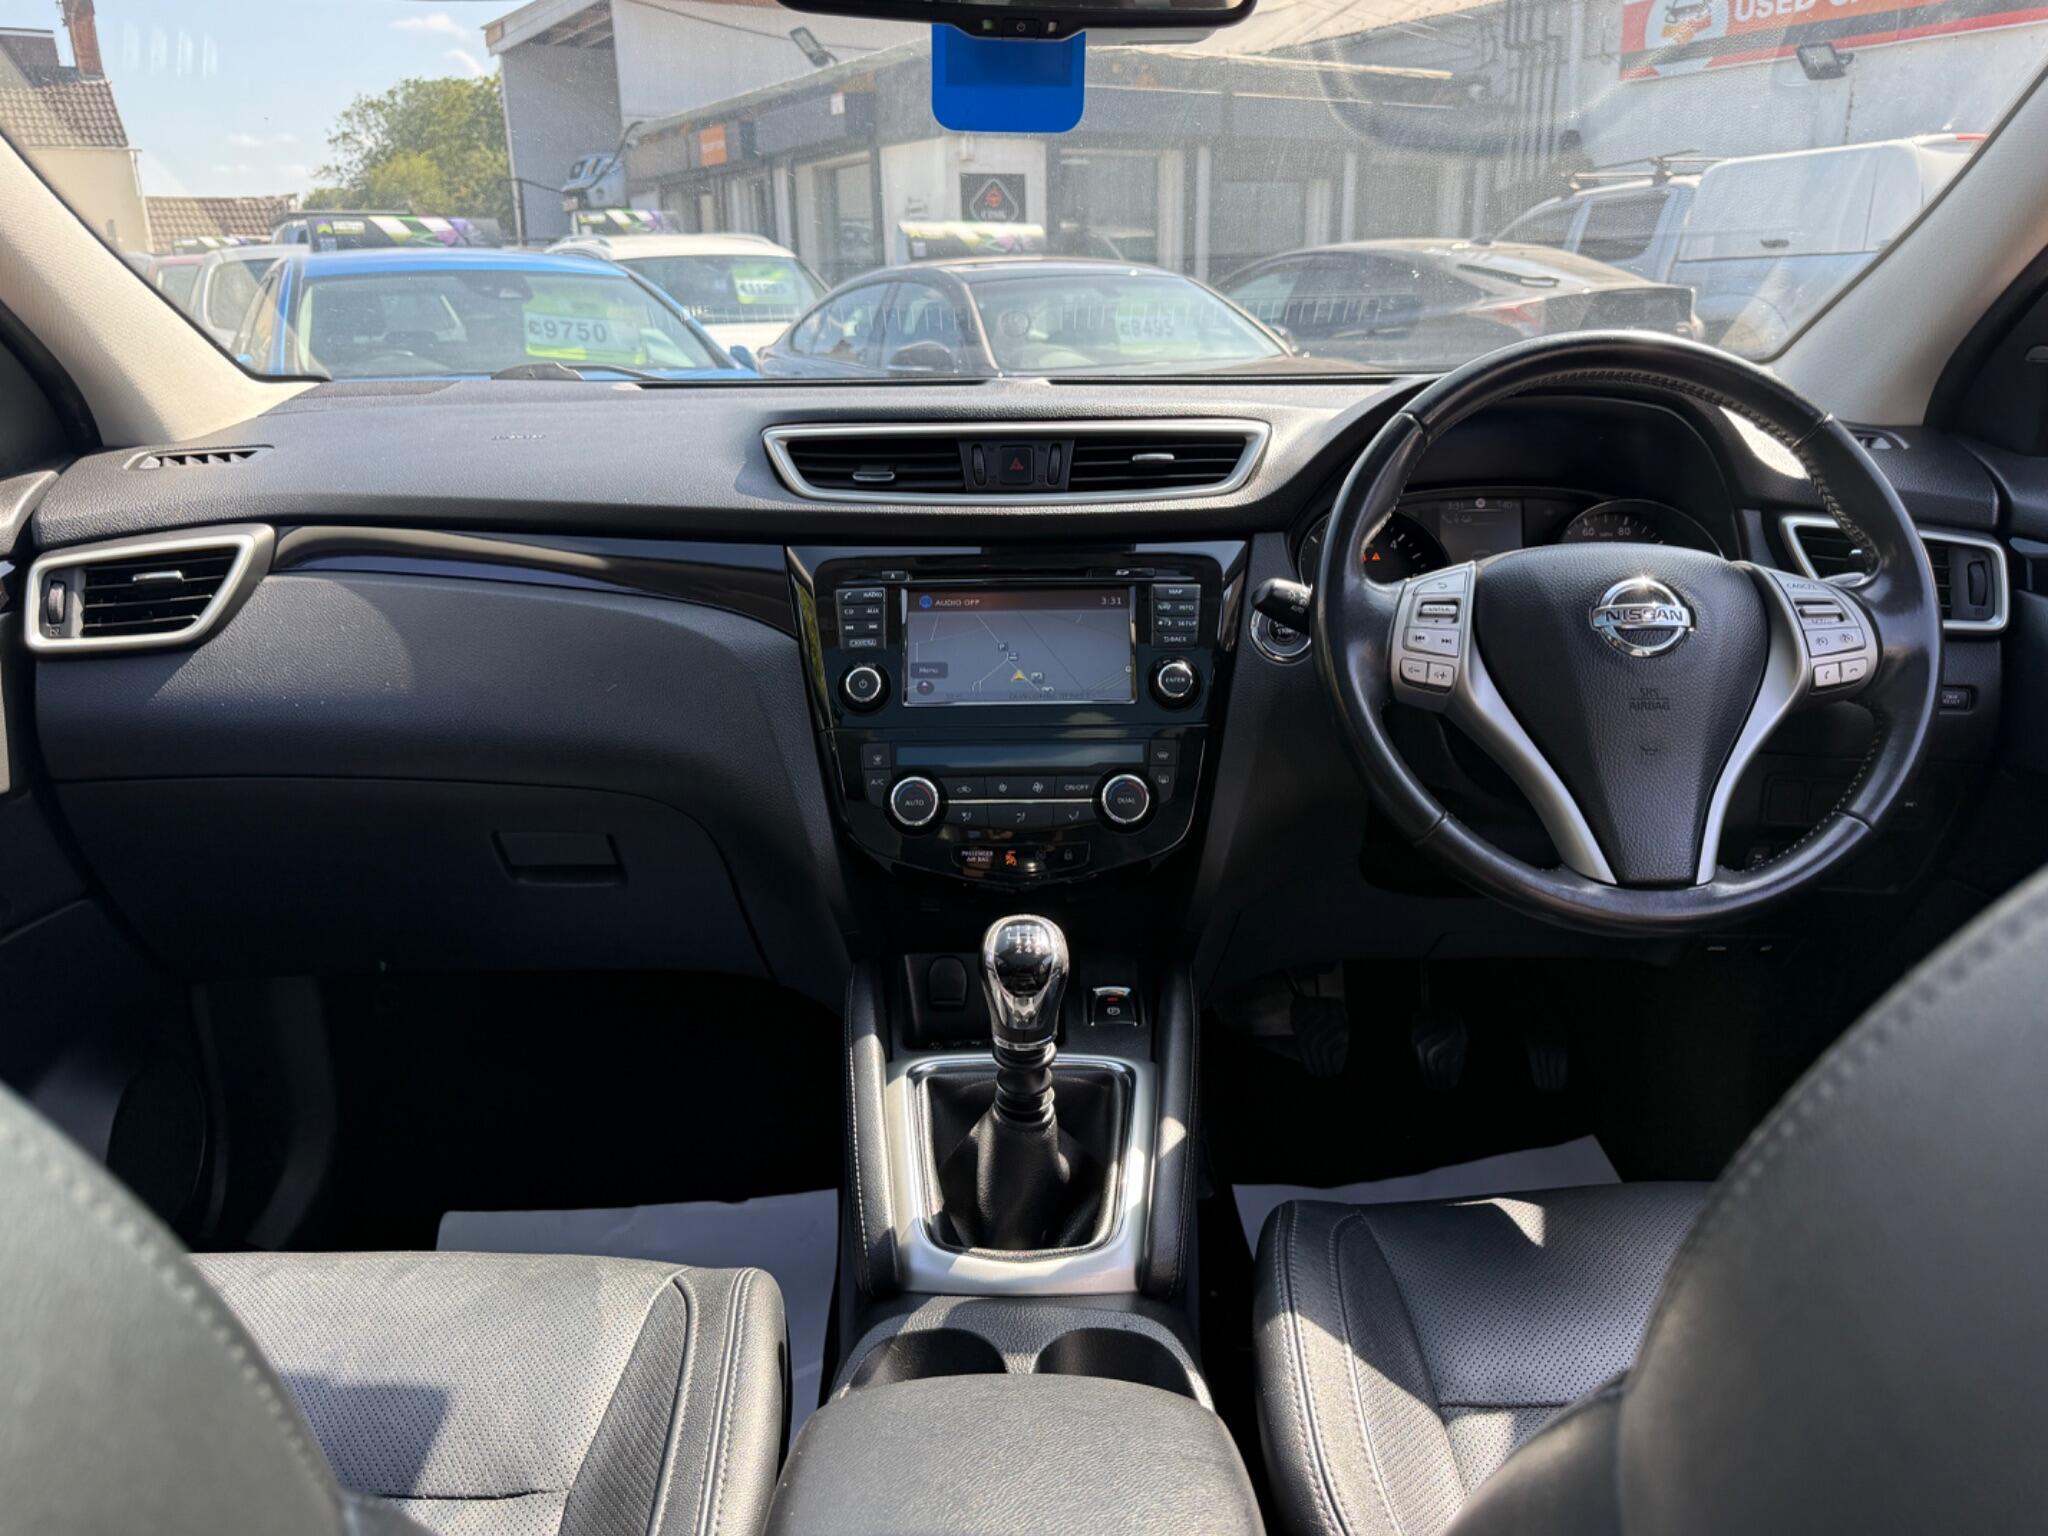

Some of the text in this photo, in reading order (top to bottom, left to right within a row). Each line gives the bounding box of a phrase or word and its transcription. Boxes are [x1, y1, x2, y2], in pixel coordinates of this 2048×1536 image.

[1581, 526, 1595, 537] 60
[1617, 526, 1632, 537] 80
[935, 599, 962, 607] AUDIO
[1101, 596, 1122, 606] 3:31
[1605, 608, 1684, 622] NISSAN
[904, 799, 925, 807] AUTO
